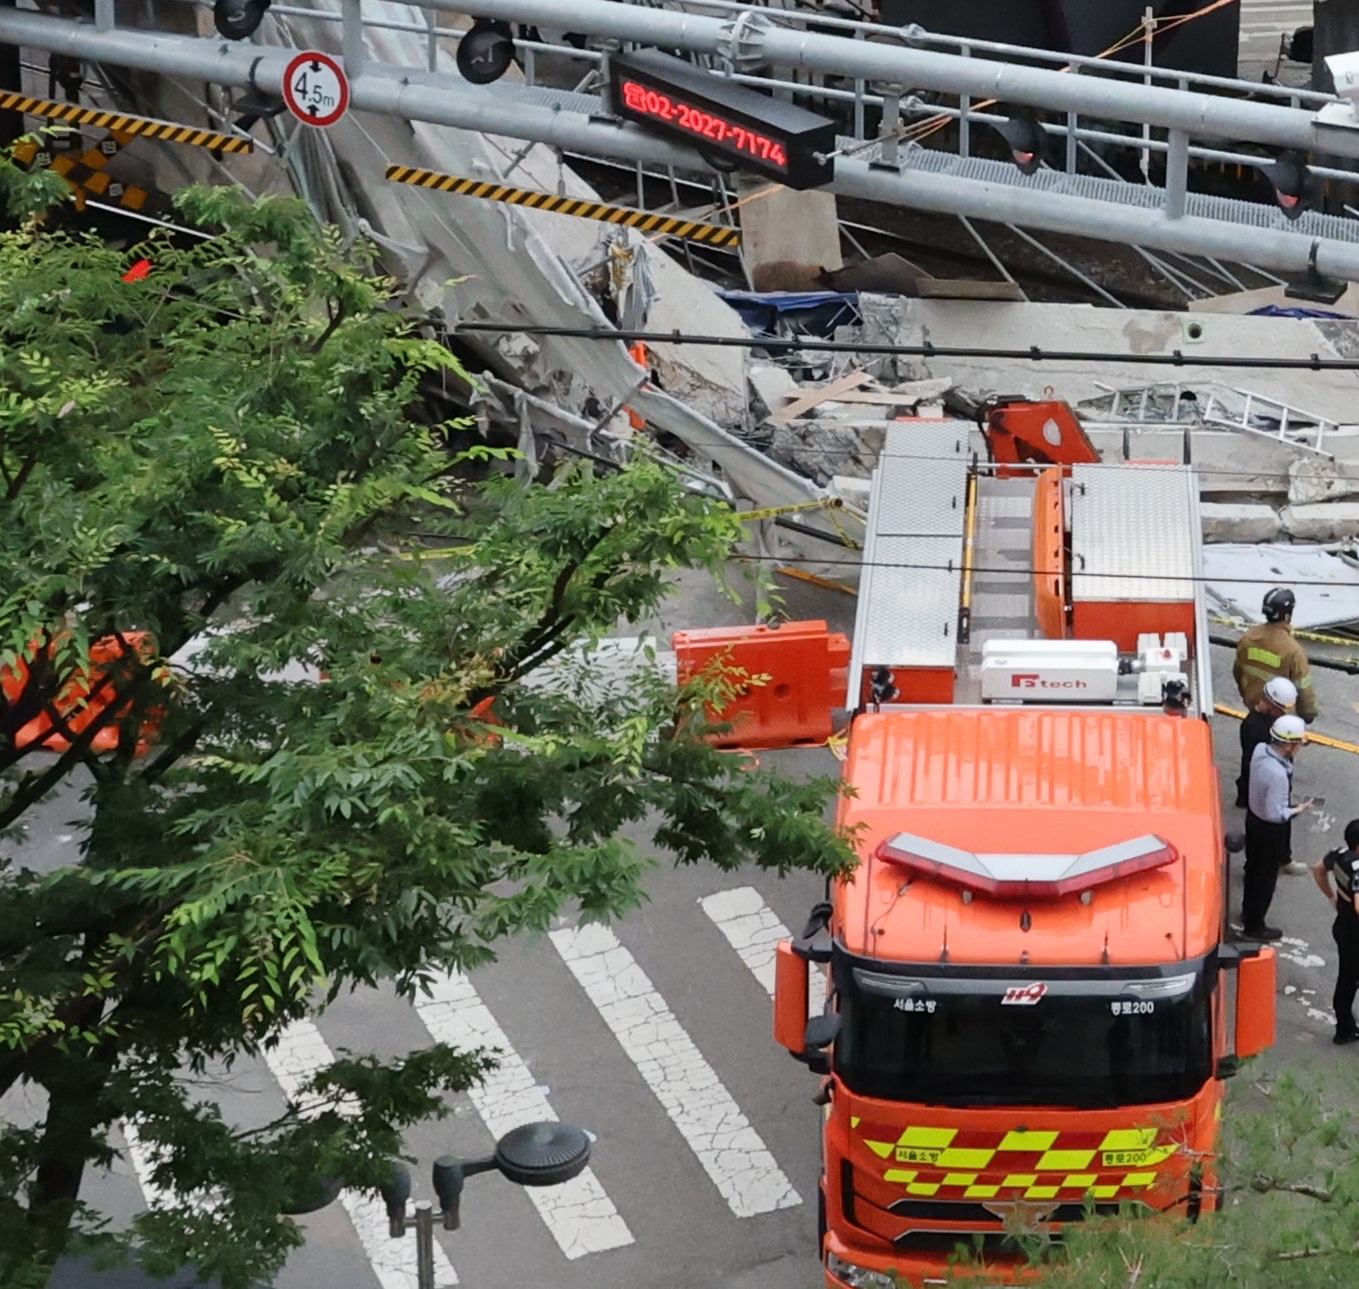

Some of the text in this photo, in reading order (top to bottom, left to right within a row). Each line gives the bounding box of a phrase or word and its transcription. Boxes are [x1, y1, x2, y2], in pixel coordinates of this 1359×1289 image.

[294, 71, 335, 107] 4.5m
[646, 90, 788, 166] 02-2027-7174
[893, 998, 937, 1014] 서울소방
[897, 1149, 940, 1163] 서울소방
